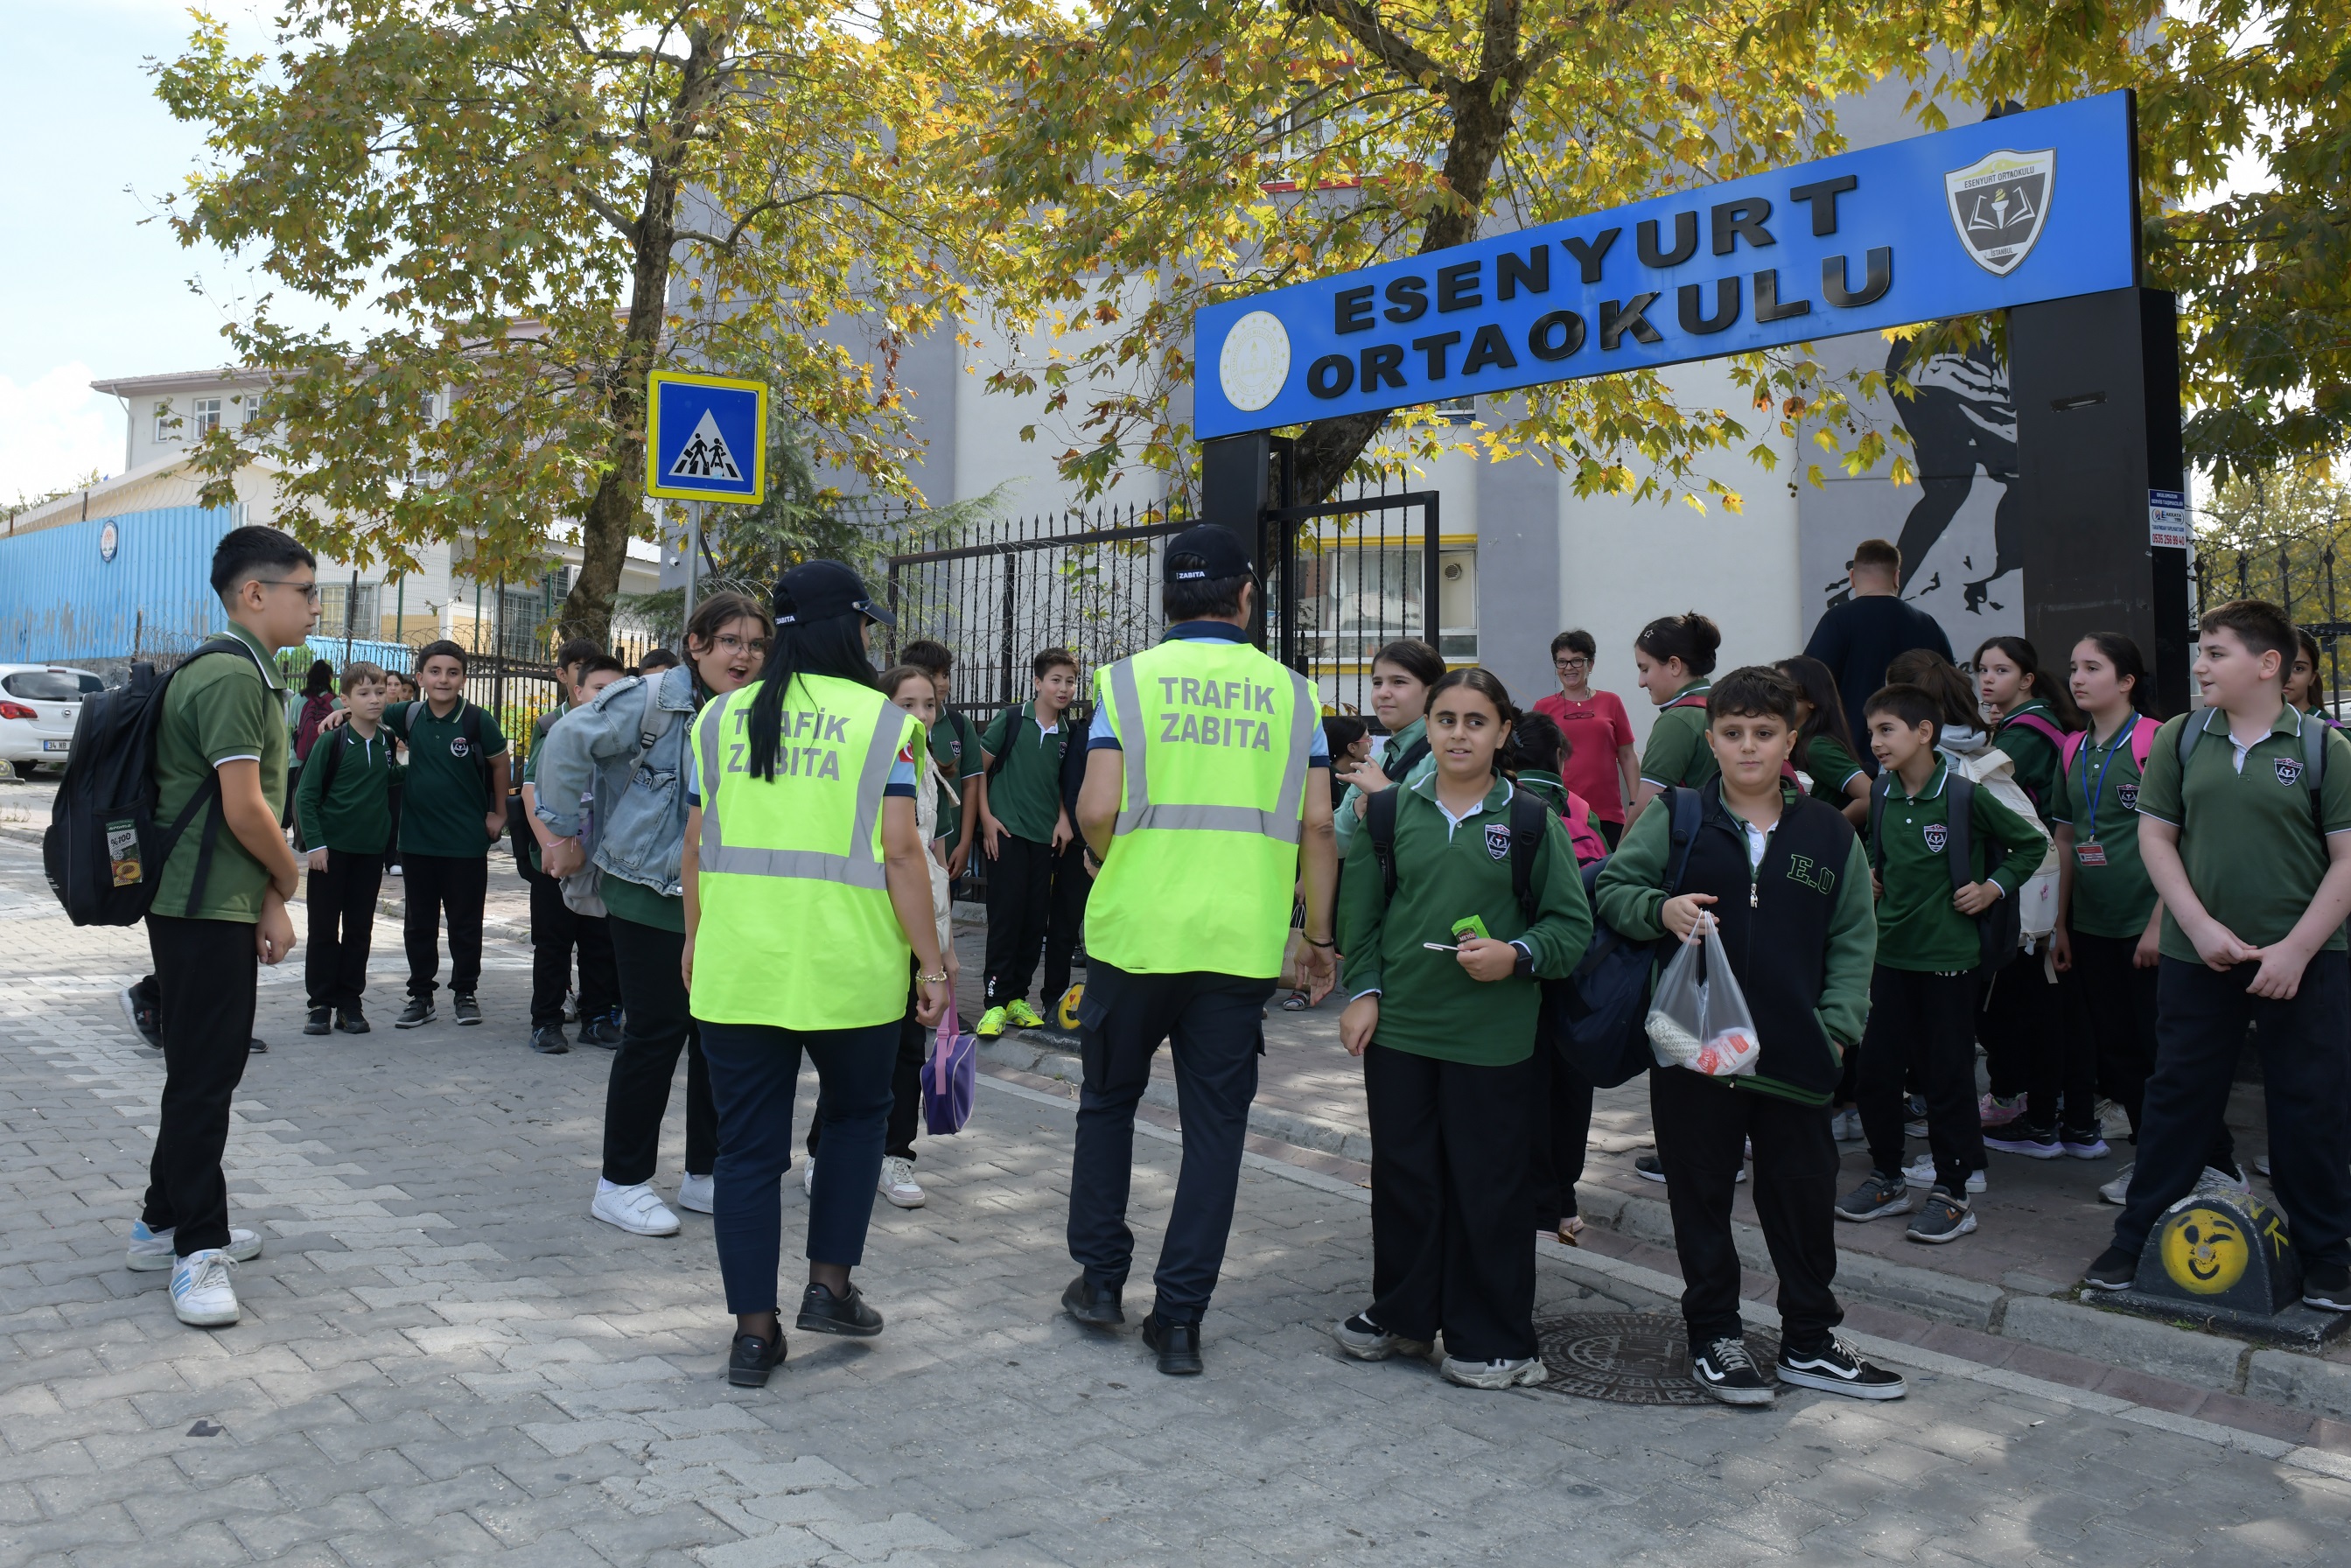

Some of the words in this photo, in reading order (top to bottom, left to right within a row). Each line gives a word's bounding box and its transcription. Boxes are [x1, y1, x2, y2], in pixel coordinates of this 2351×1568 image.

[1964, 174, 1997, 189] ESENYURT
[1998, 165, 2035, 181] ORTAOKULU
[1334, 174, 1858, 335] ESENYURT
[1991, 247, 2013, 257] İSTANBUL
[1305, 245, 1893, 399] ORTAOKULU
[1158, 676, 1276, 715] TRAFİK
[734, 707, 851, 744] TAFİK
[1160, 712, 1270, 752] ZABITA
[727, 743, 841, 781] ZBITA
[110, 832, 131, 846] %100
